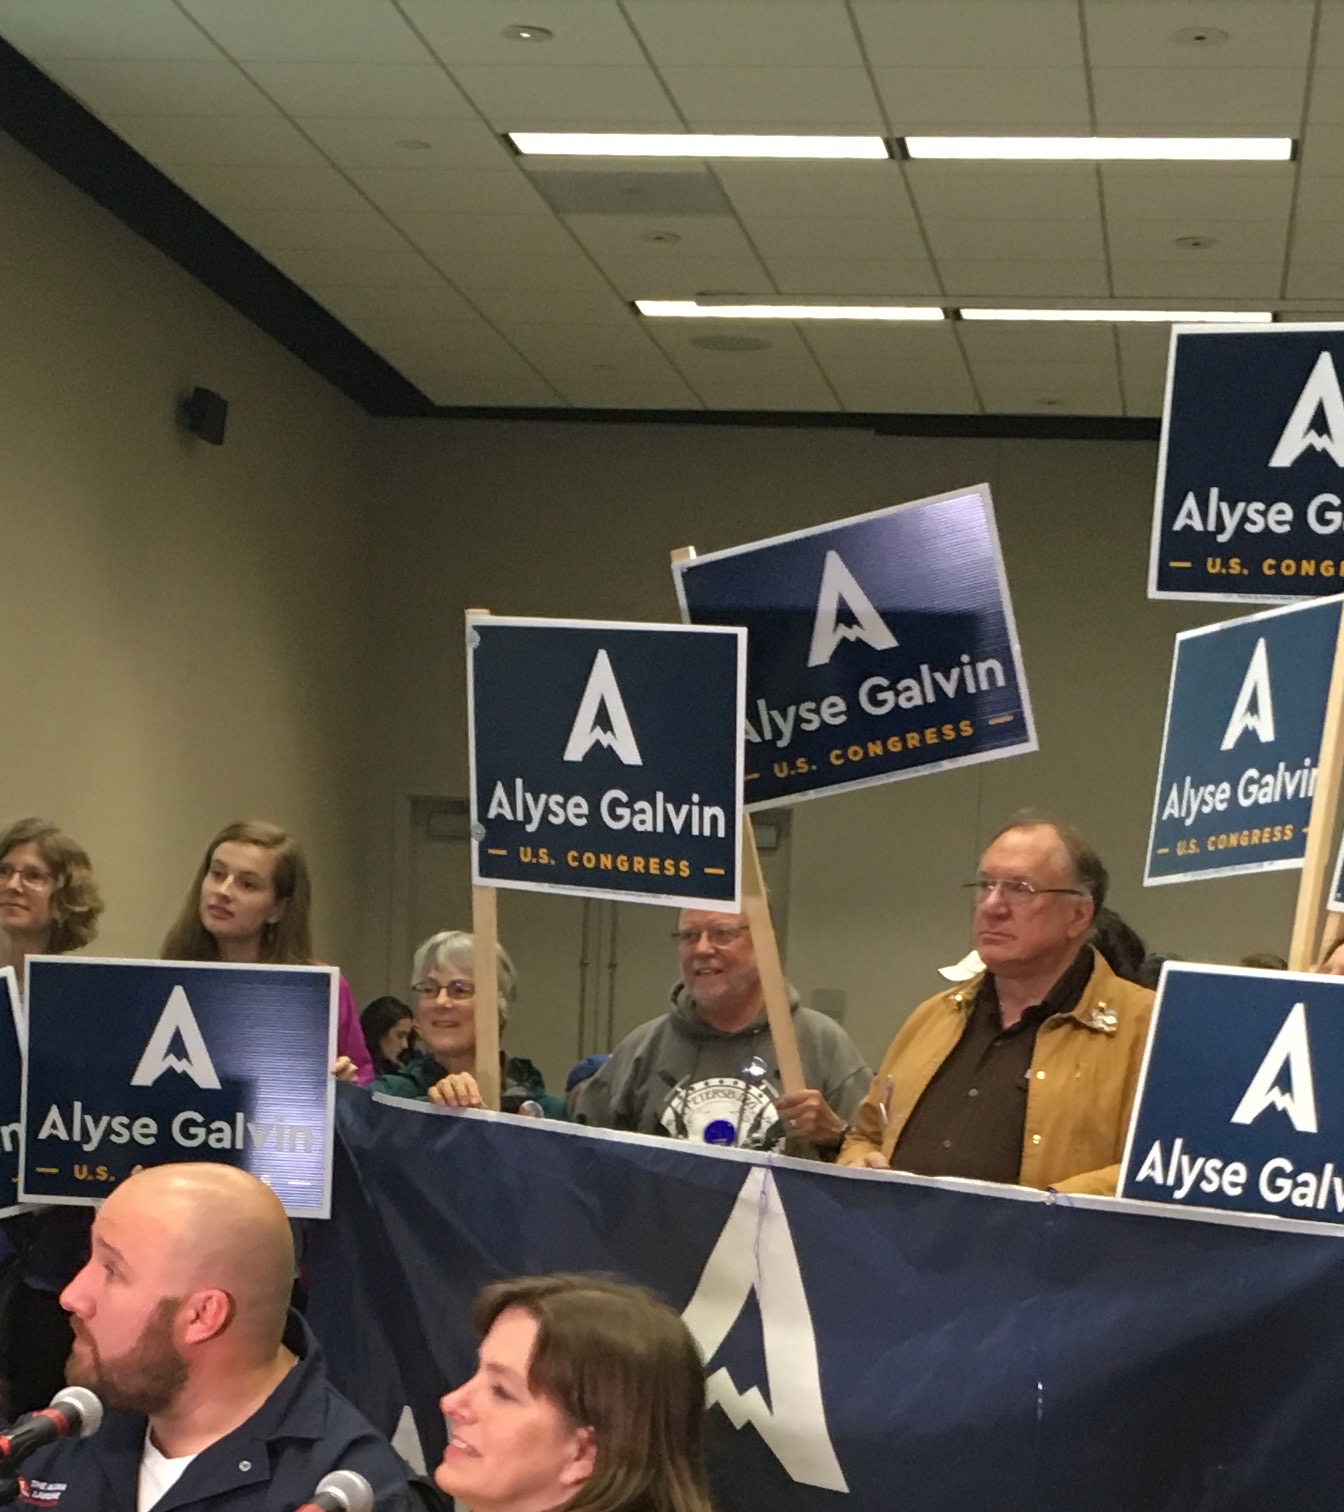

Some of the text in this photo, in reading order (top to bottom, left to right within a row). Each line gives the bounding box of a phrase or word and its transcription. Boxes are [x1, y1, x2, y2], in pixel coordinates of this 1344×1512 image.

[1172, 487, 1294, 543] Alyse
[1207, 557, 1249, 575] U.S.
[858, 654, 1006, 716] Galvin
[773, 719, 975, 779] U.S. CONGRESS
[487, 778, 726, 838] Alyse Galvin
[1162, 775, 1231, 826] Alyse
[519, 846, 691, 877] U.S. CONGRESS
[1176, 824, 1294, 856] U.S. CONGRESS
[37, 1101, 314, 1154] Alyse Galvin
[73, 1163, 115, 1182] U.S.
[1136, 1137, 1247, 1199] Alyse
